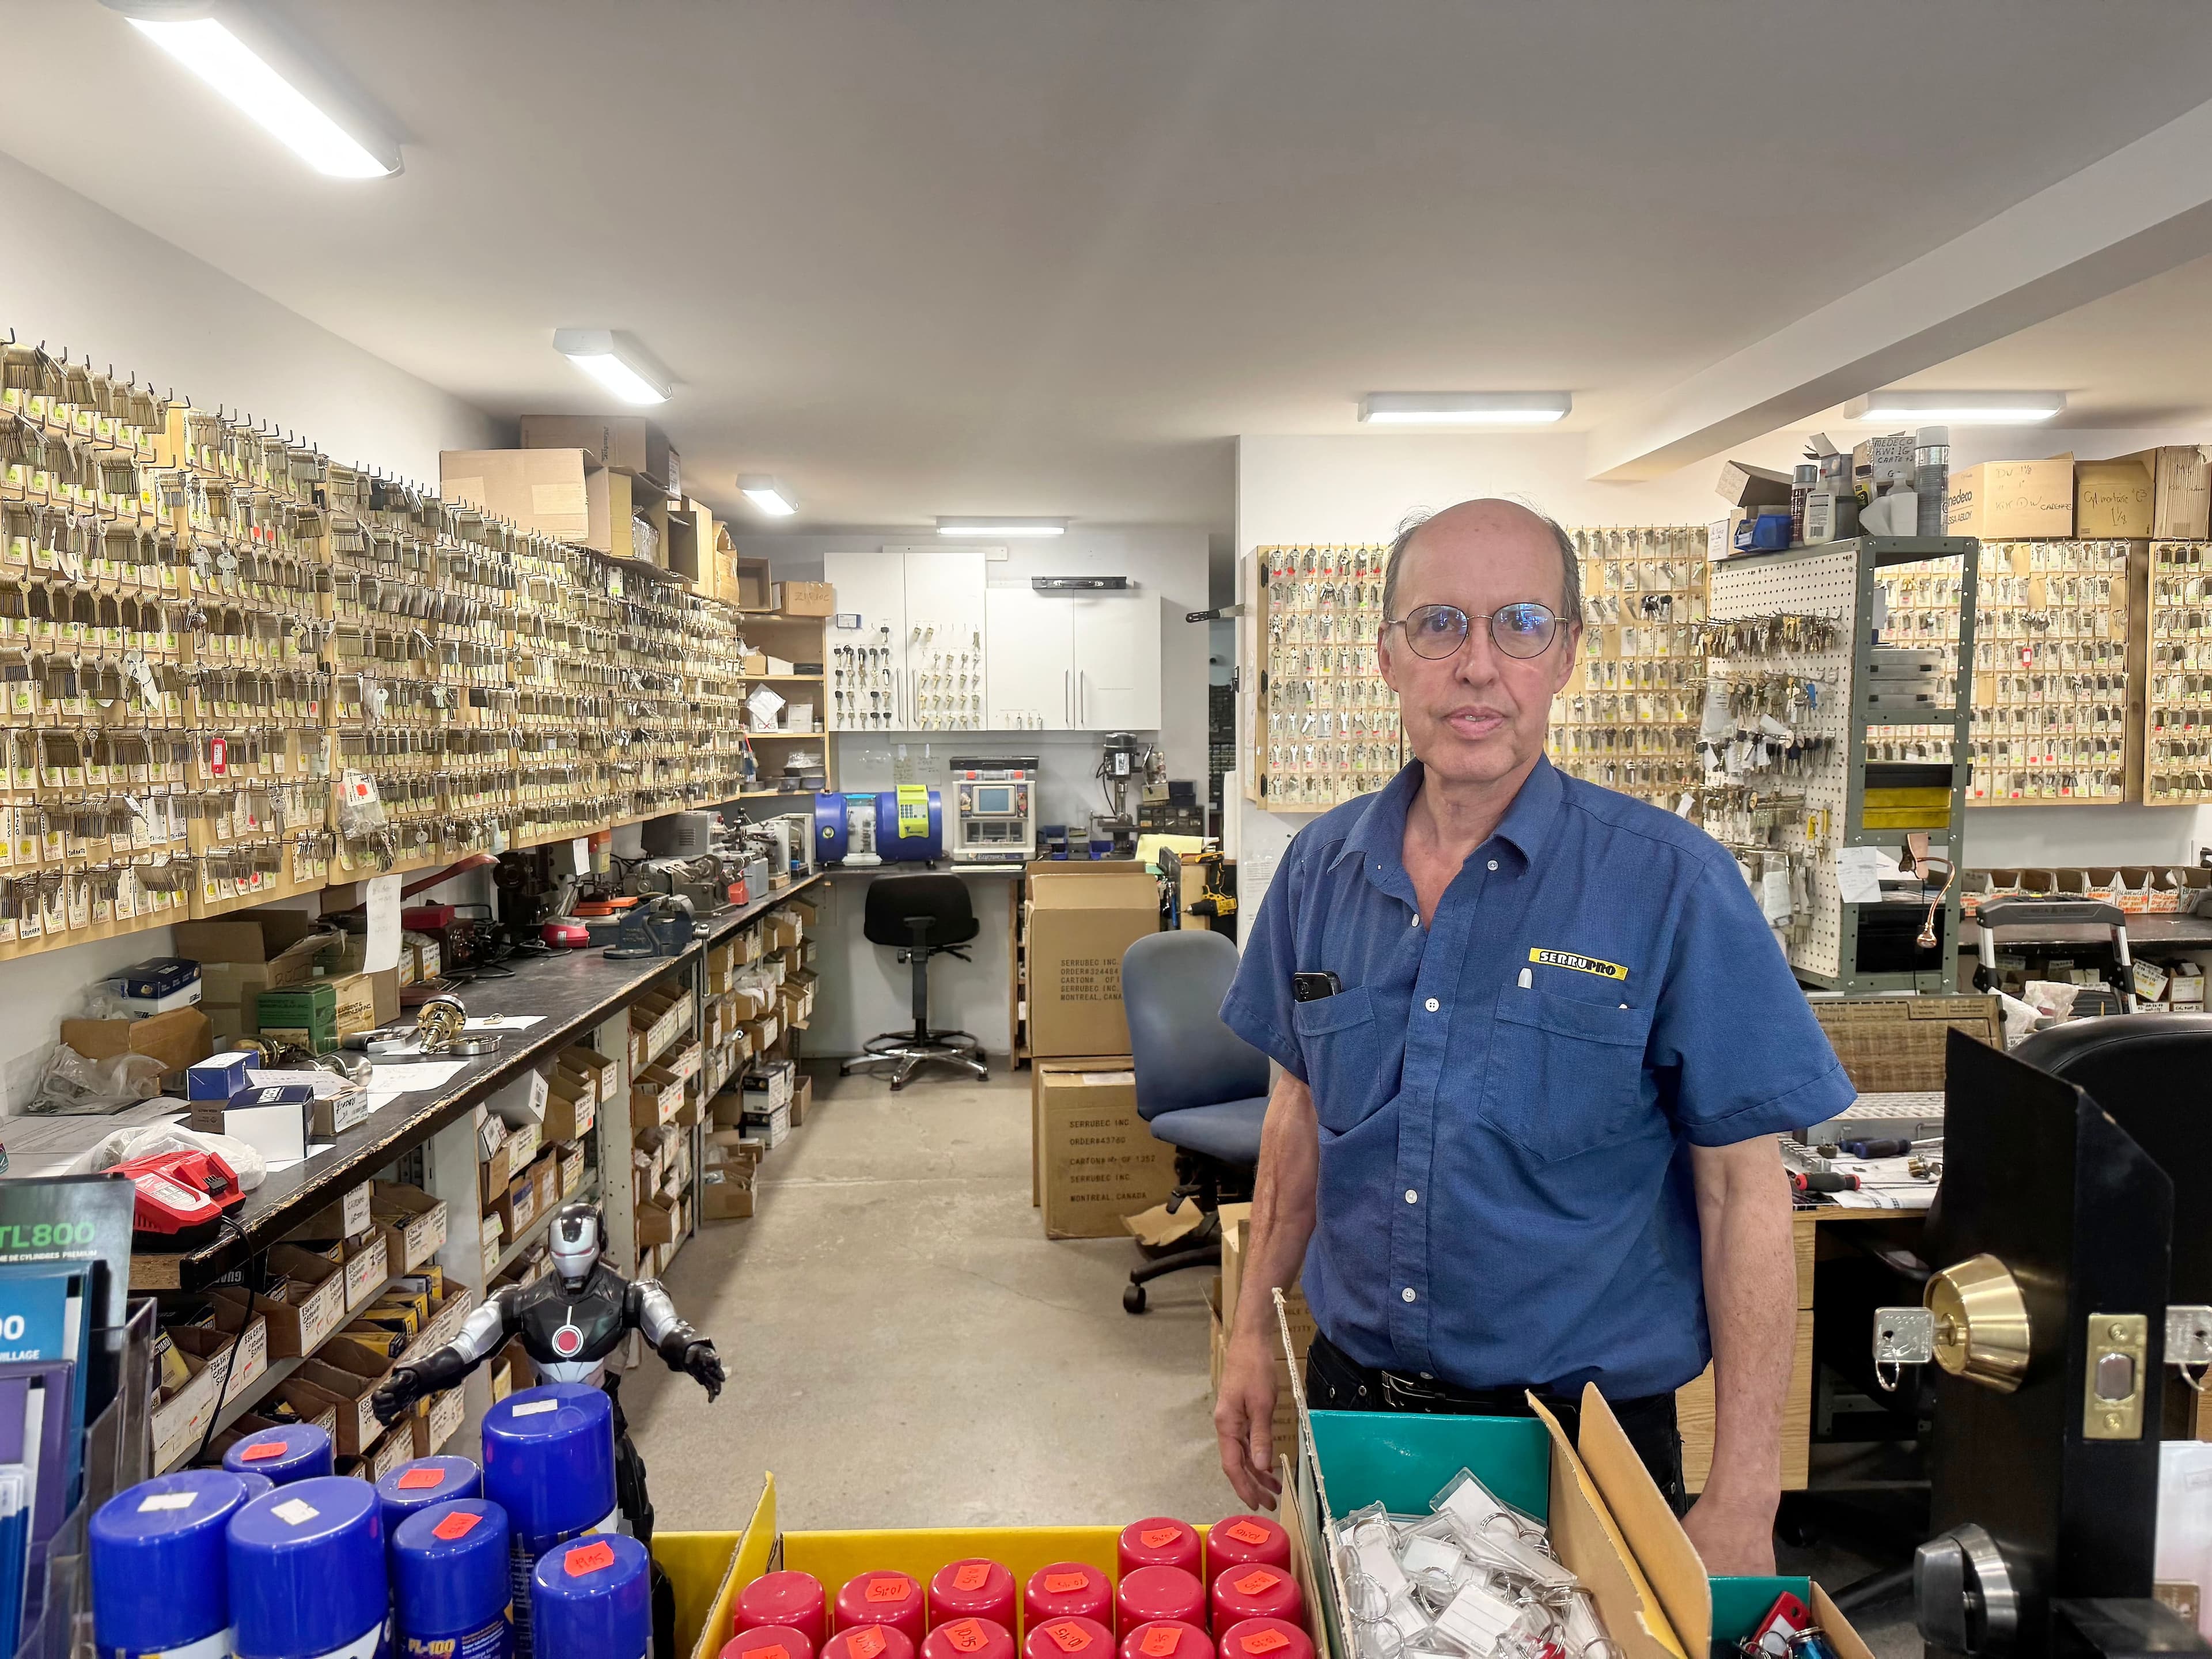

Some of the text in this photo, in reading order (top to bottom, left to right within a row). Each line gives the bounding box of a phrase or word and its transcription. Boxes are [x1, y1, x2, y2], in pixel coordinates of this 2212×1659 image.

[1874, 438, 1913, 448] MEDECO
[1948, 510, 1972, 525] SSA ABLOY
[1539, 950, 1616, 976] SERRUPRO
[1069, 1119, 1111, 1128] SERRUBEC
[1070, 1174, 1112, 1183] SERRUBEC
[1116, 1191, 1147, 1200] CANADA
[0, 1221, 96, 1248] TL800
[62, 1249, 97, 1259] PREMIUM
[955, 1627, 976, 1648] 10.95
[408, 1638, 456, 1655] PL-100
